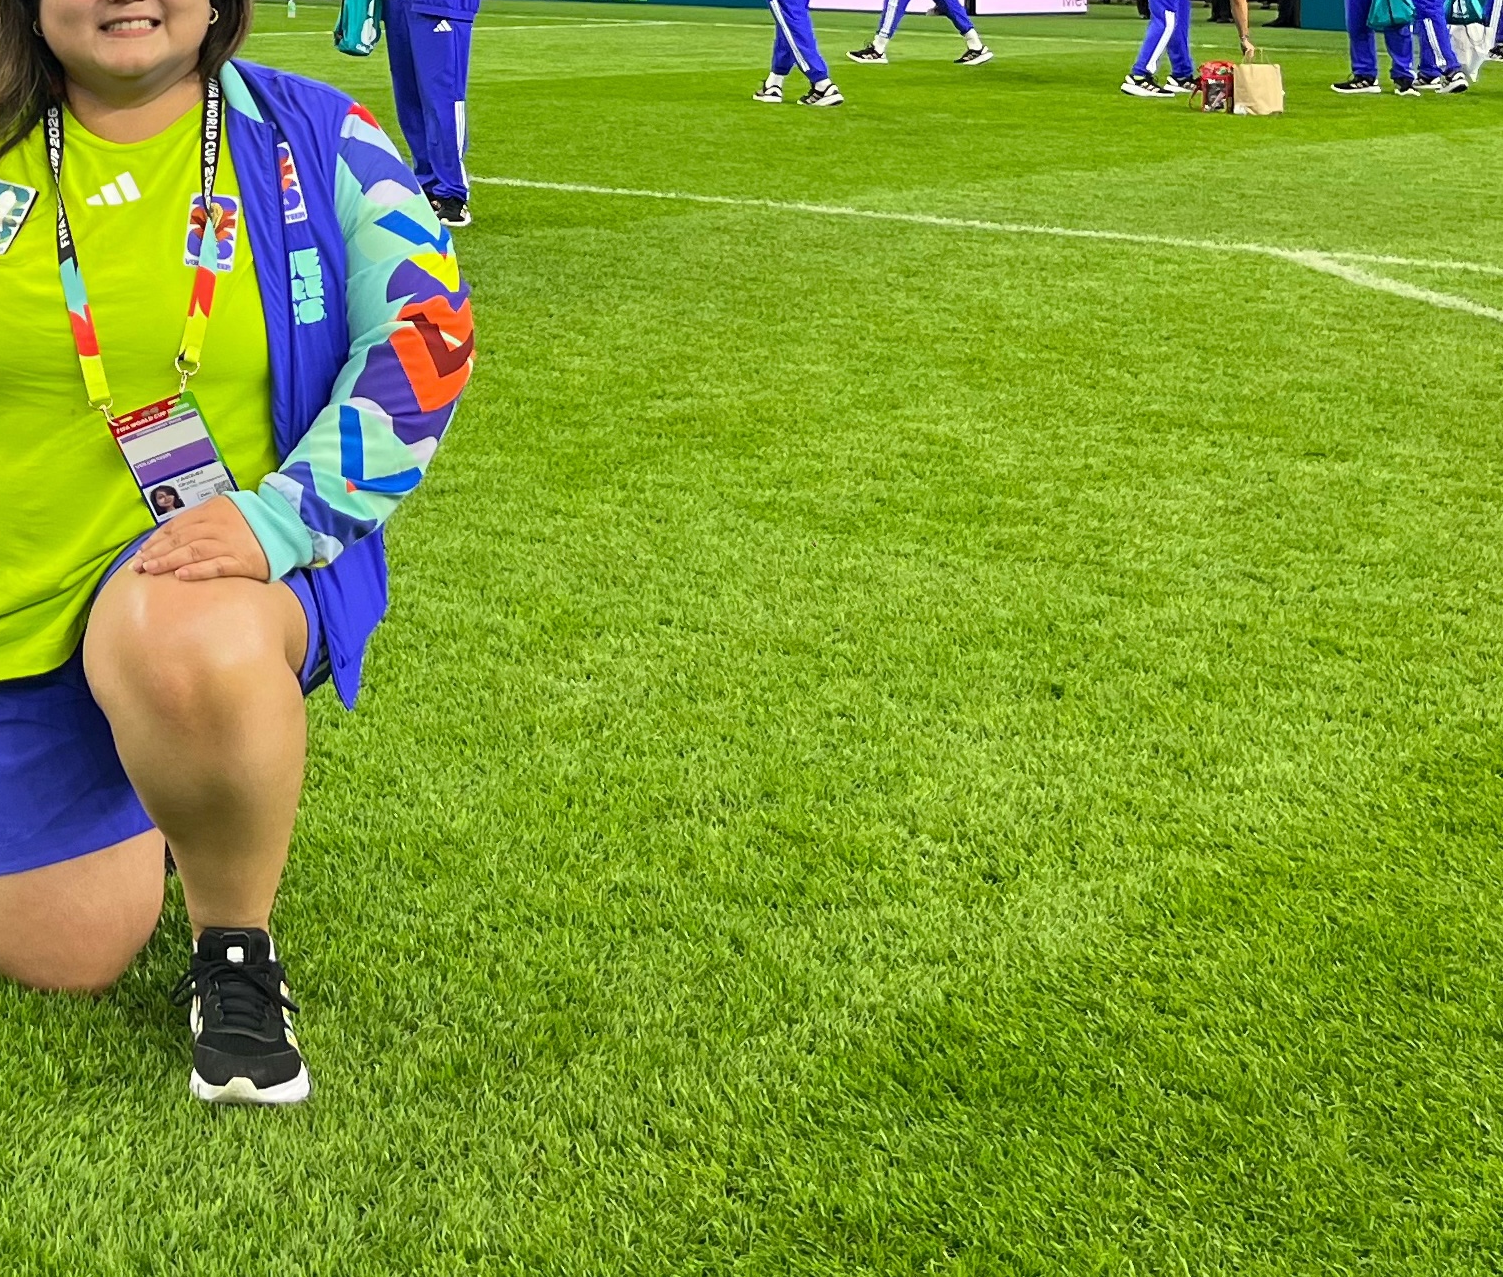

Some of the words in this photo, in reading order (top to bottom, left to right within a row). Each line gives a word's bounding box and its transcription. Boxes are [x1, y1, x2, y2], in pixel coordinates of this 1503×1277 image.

[208, 77, 220, 98] FIFA
[48, 107, 61, 148] 2026
[205, 100, 219, 140] WORLD
[204, 141, 217, 165] CUP
